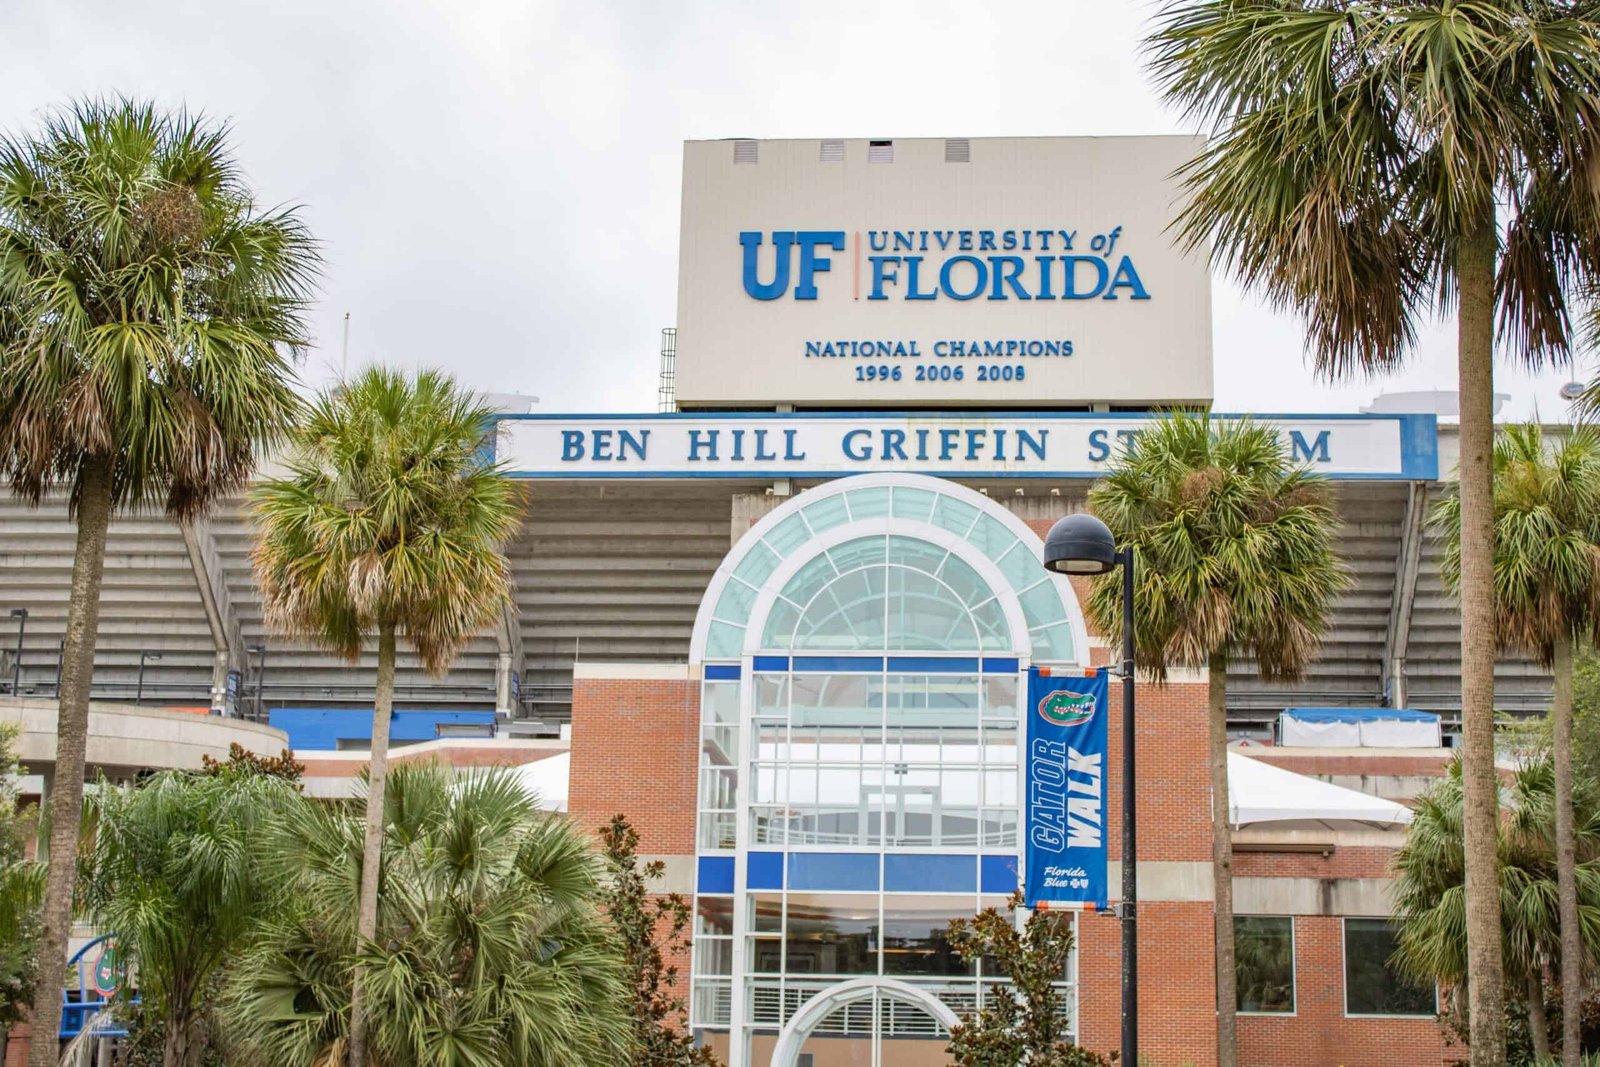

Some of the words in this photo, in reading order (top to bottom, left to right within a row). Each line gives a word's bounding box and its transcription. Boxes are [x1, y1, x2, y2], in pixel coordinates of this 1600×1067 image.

[868, 230, 1078, 251] UNIVERSITY
[1090, 225, 1121, 255] of
[738, 231, 845, 301] UF
[867, 255, 1152, 301] FLORIDA
[805, 340, 921, 357] NATIONAL
[933, 340, 1073, 357] CHAMPIONS
[856, 364, 902, 381] 1996
[915, 364, 965, 381] 2006
[977, 364, 1026, 381] 2008
[561, 429, 651, 461] BEN
[688, 429, 806, 461] HILL
[841, 429, 1049, 461] GRIFFIN
[1032, 738, 1066, 853] GATOR
[1067, 747, 1101, 848] WALK
[1043, 877, 1068, 888] Blue
[1044, 867, 1087, 878] Florida
